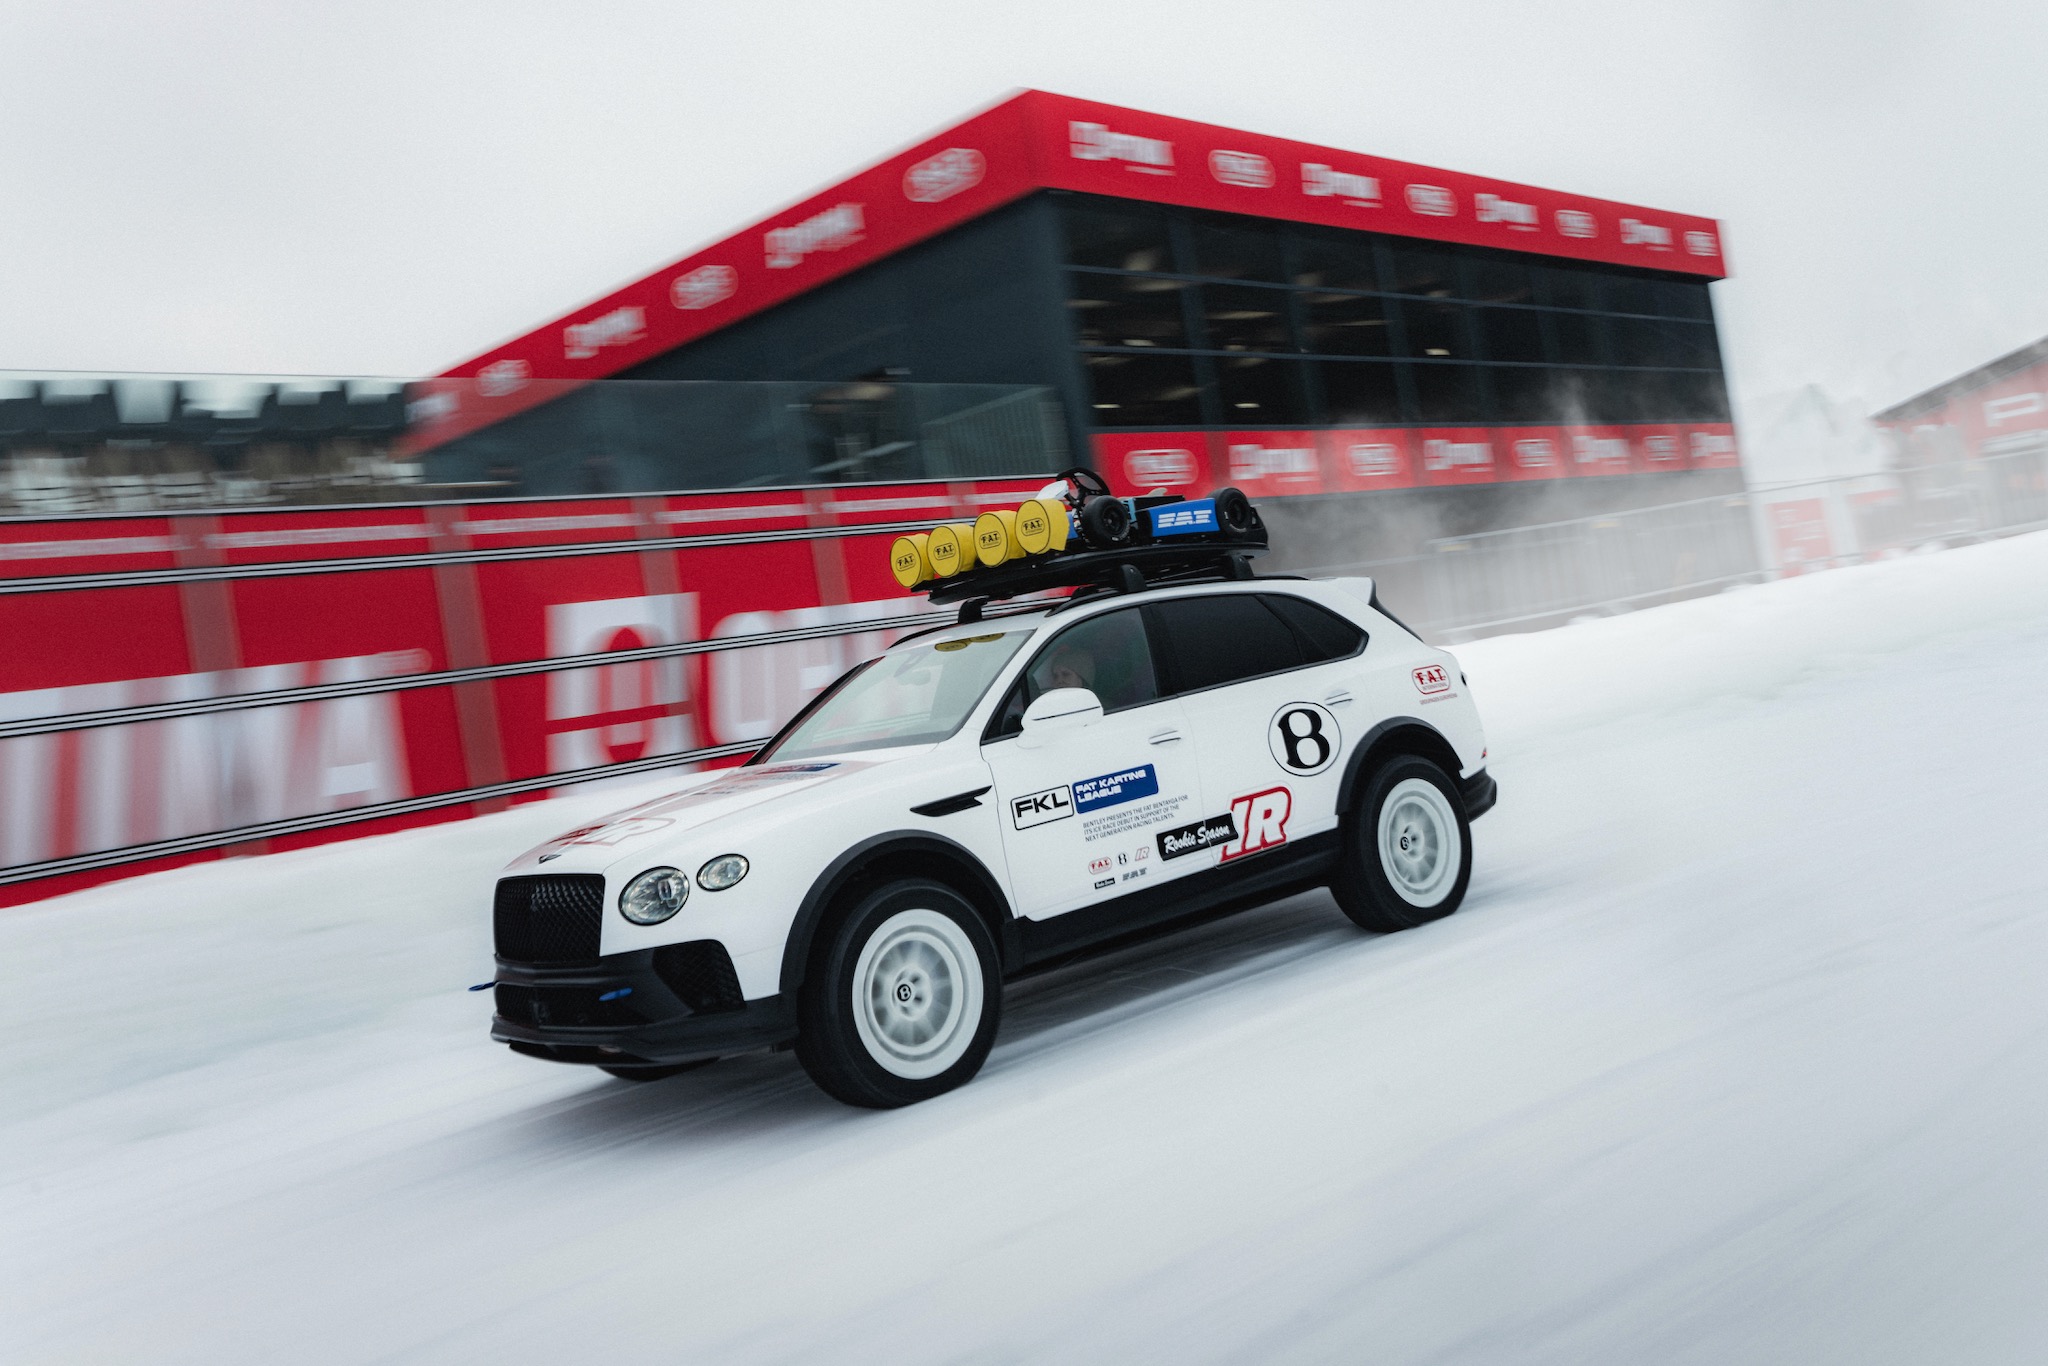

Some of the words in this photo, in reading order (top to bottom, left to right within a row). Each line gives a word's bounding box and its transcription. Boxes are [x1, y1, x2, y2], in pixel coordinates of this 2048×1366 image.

[1075, 781, 1098, 795] FAT
[1099, 769, 1147, 787] KARTING
[1077, 784, 1122, 804] LEAGUE
[1015, 792, 1069, 818] FKL
[1082, 817, 1107, 829] BENTLEY
[1107, 810, 1133, 823] PRESENTS
[1133, 807, 1144, 816] THE
[1143, 804, 1152, 814] FAT
[1153, 798, 1178, 811] BENTAYGA
[1178, 794, 1189, 803] FOR
[1083, 827, 1093, 836] ITS
[1093, 825, 1102, 833] ICE
[1102, 822, 1116, 831] RACE
[1116, 818, 1133, 828] DEBUT
[1140, 809, 1162, 820] SUPPORT
[1085, 833, 1099, 843] NEXT
[1099, 824, 1133, 839] GENERATION
[1132, 820, 1153, 830] RACING
[1163, 830, 1197, 854] Rookie
[1197, 825, 1231, 844] Season
